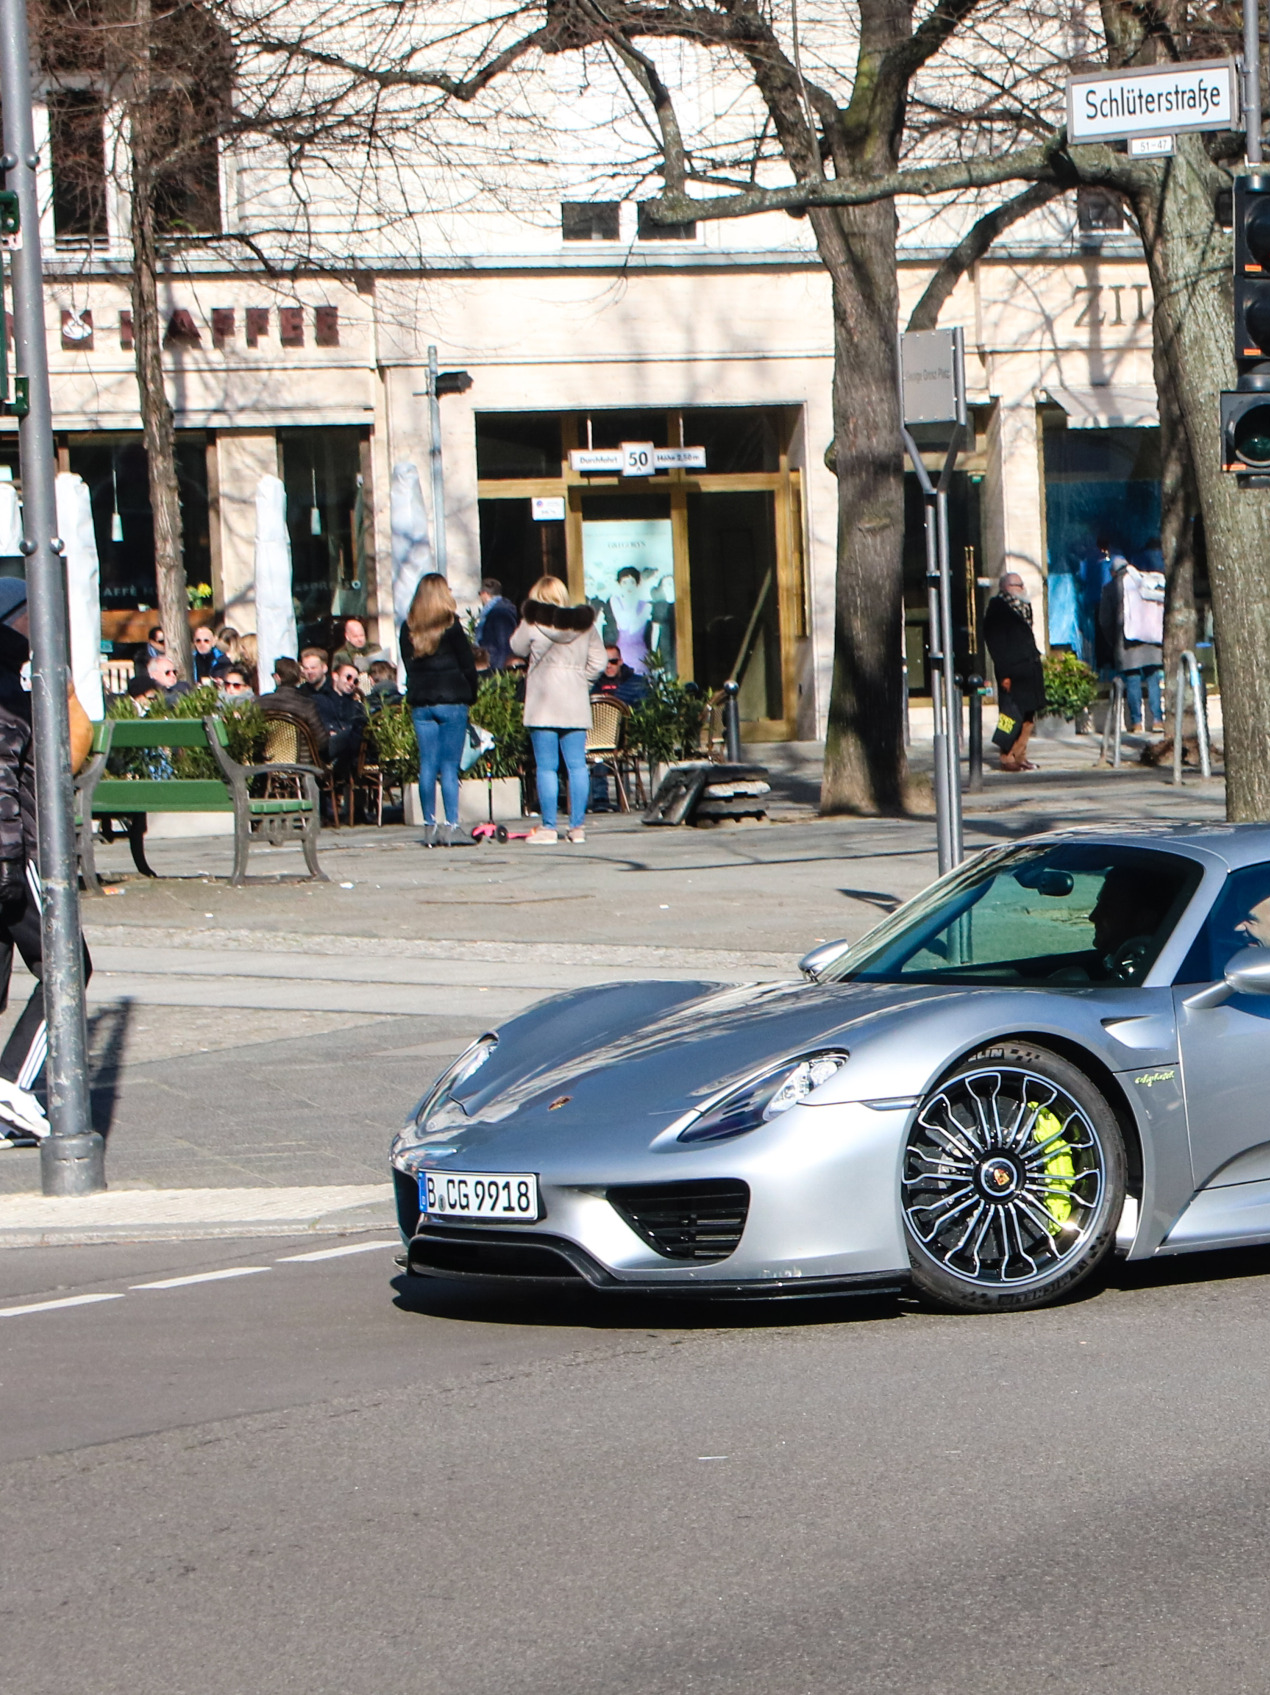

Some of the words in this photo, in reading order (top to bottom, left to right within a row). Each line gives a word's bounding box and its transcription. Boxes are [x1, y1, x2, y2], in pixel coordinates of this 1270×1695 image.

[1085, 78, 1221, 120] Schlüterstraße
[580, 456, 618, 464] Durchfahrt
[629, 451, 648, 467] 50
[103, 584, 137, 597] AFFÈ
[427, 1177, 437, 1209] B
[446, 1178, 470, 1211] CG
[474, 1180, 531, 1213] 9918
